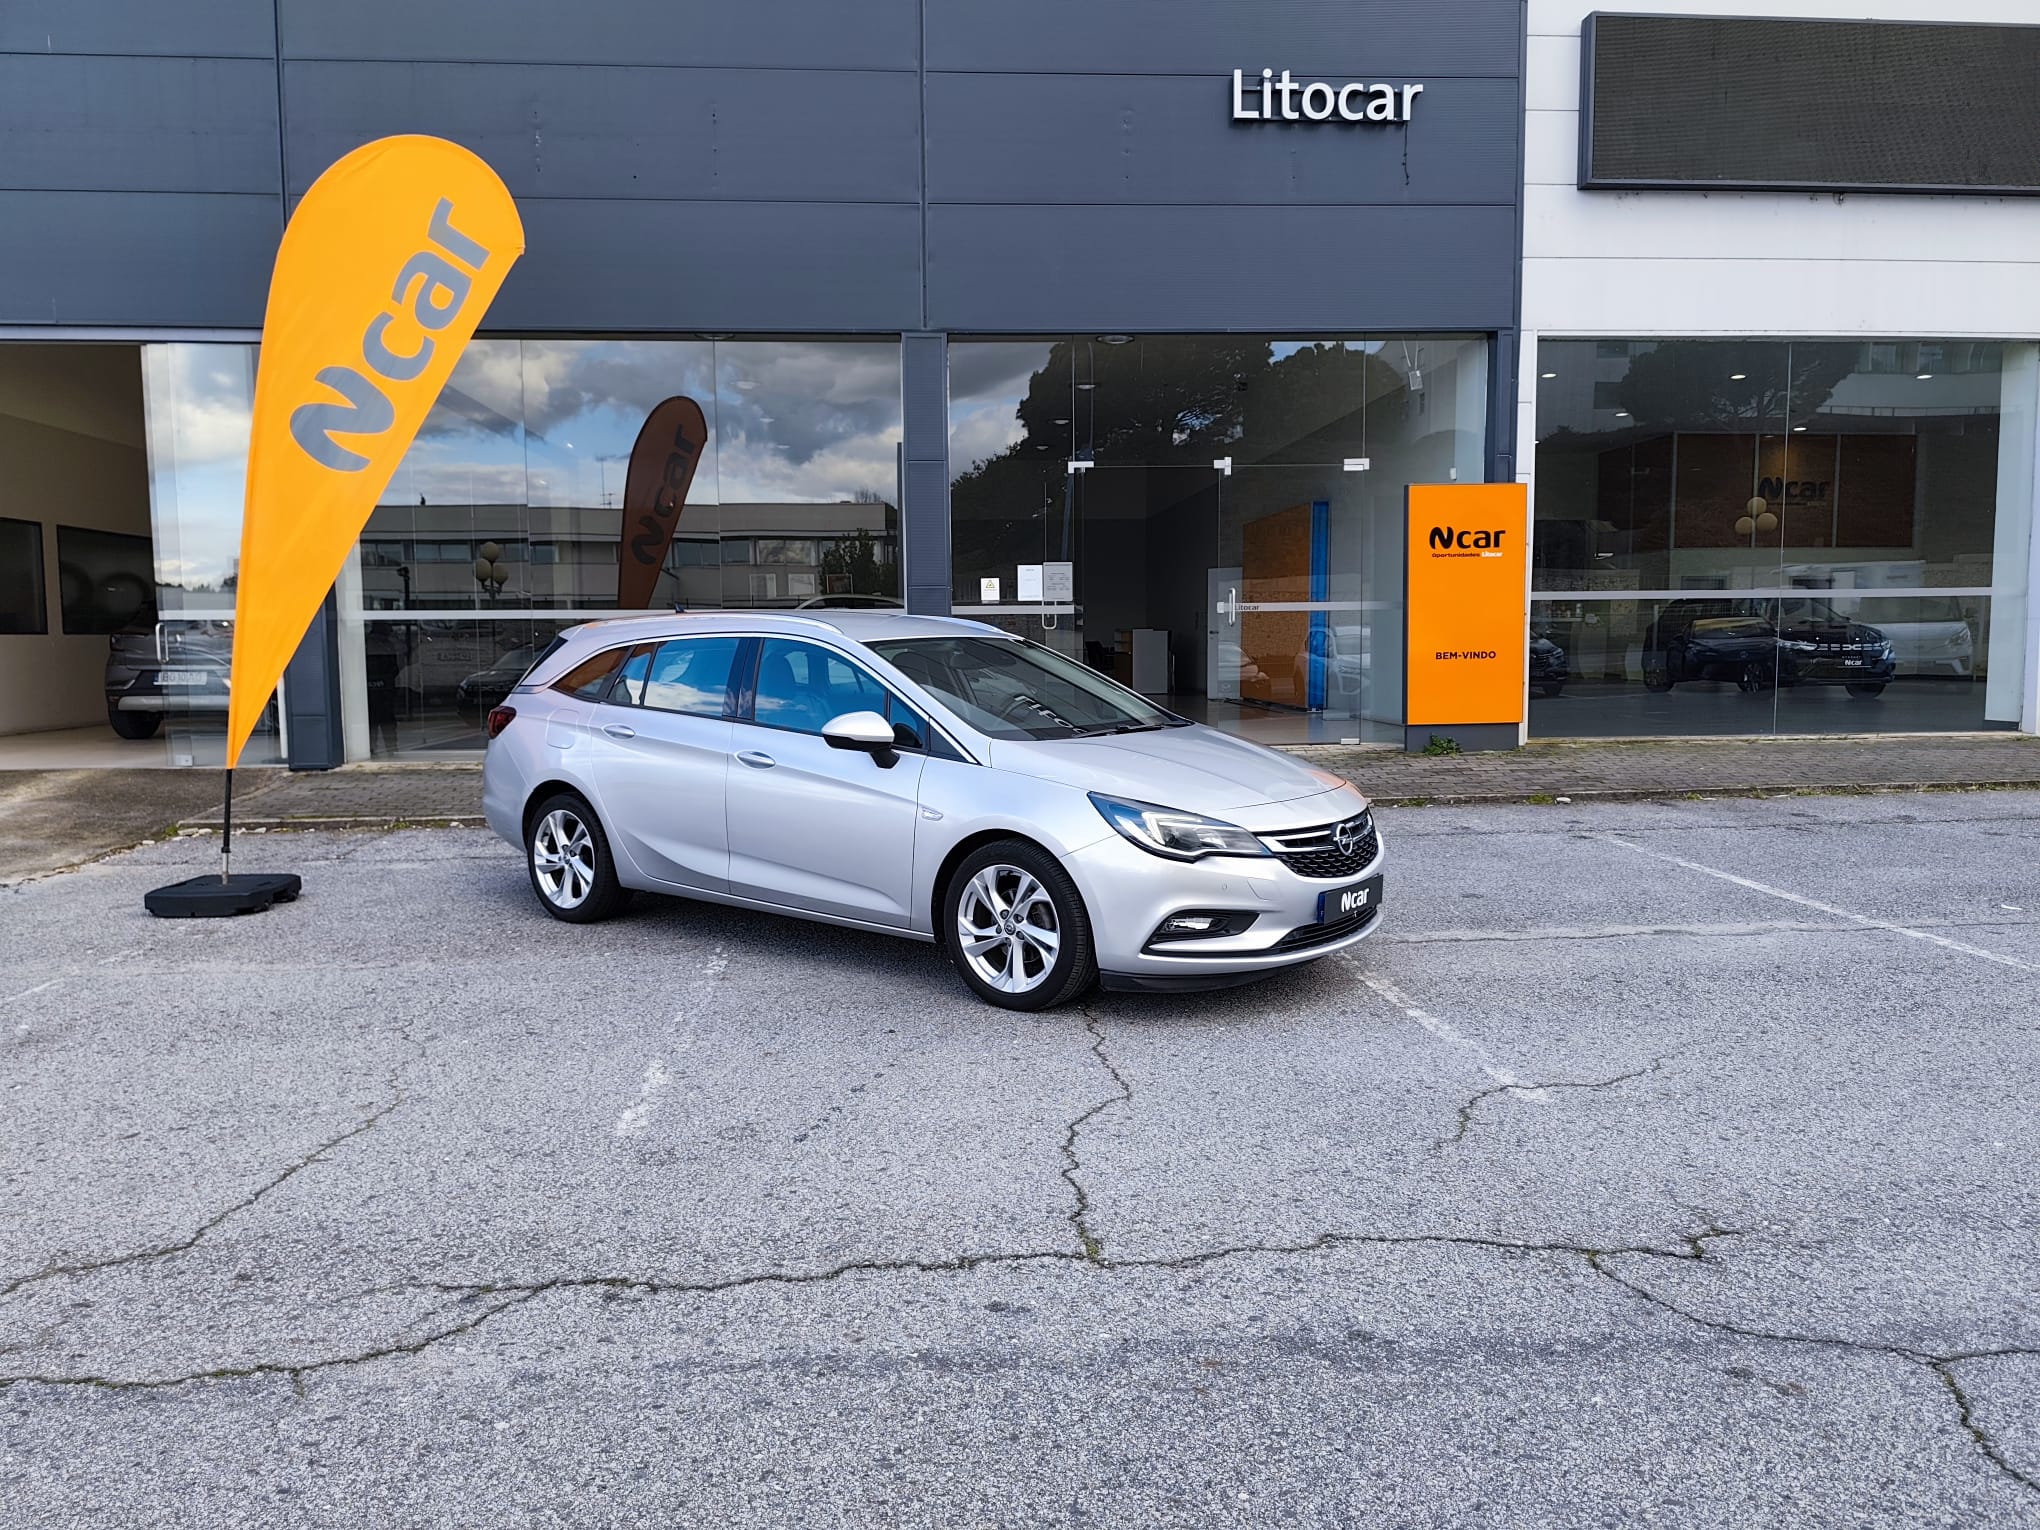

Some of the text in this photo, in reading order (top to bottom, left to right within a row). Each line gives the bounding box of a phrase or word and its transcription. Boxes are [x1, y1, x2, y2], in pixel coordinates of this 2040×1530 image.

[1232, 68, 1424, 121] Litocar
[289, 195, 491, 473] Ncar
[631, 423, 695, 565] Ncar
[1759, 476, 1829, 497] Ncar
[1429, 526, 1506, 550] Ncar
[1435, 651, 1497, 660] BEM-VINDO
[1341, 888, 1370, 913] Ncar
